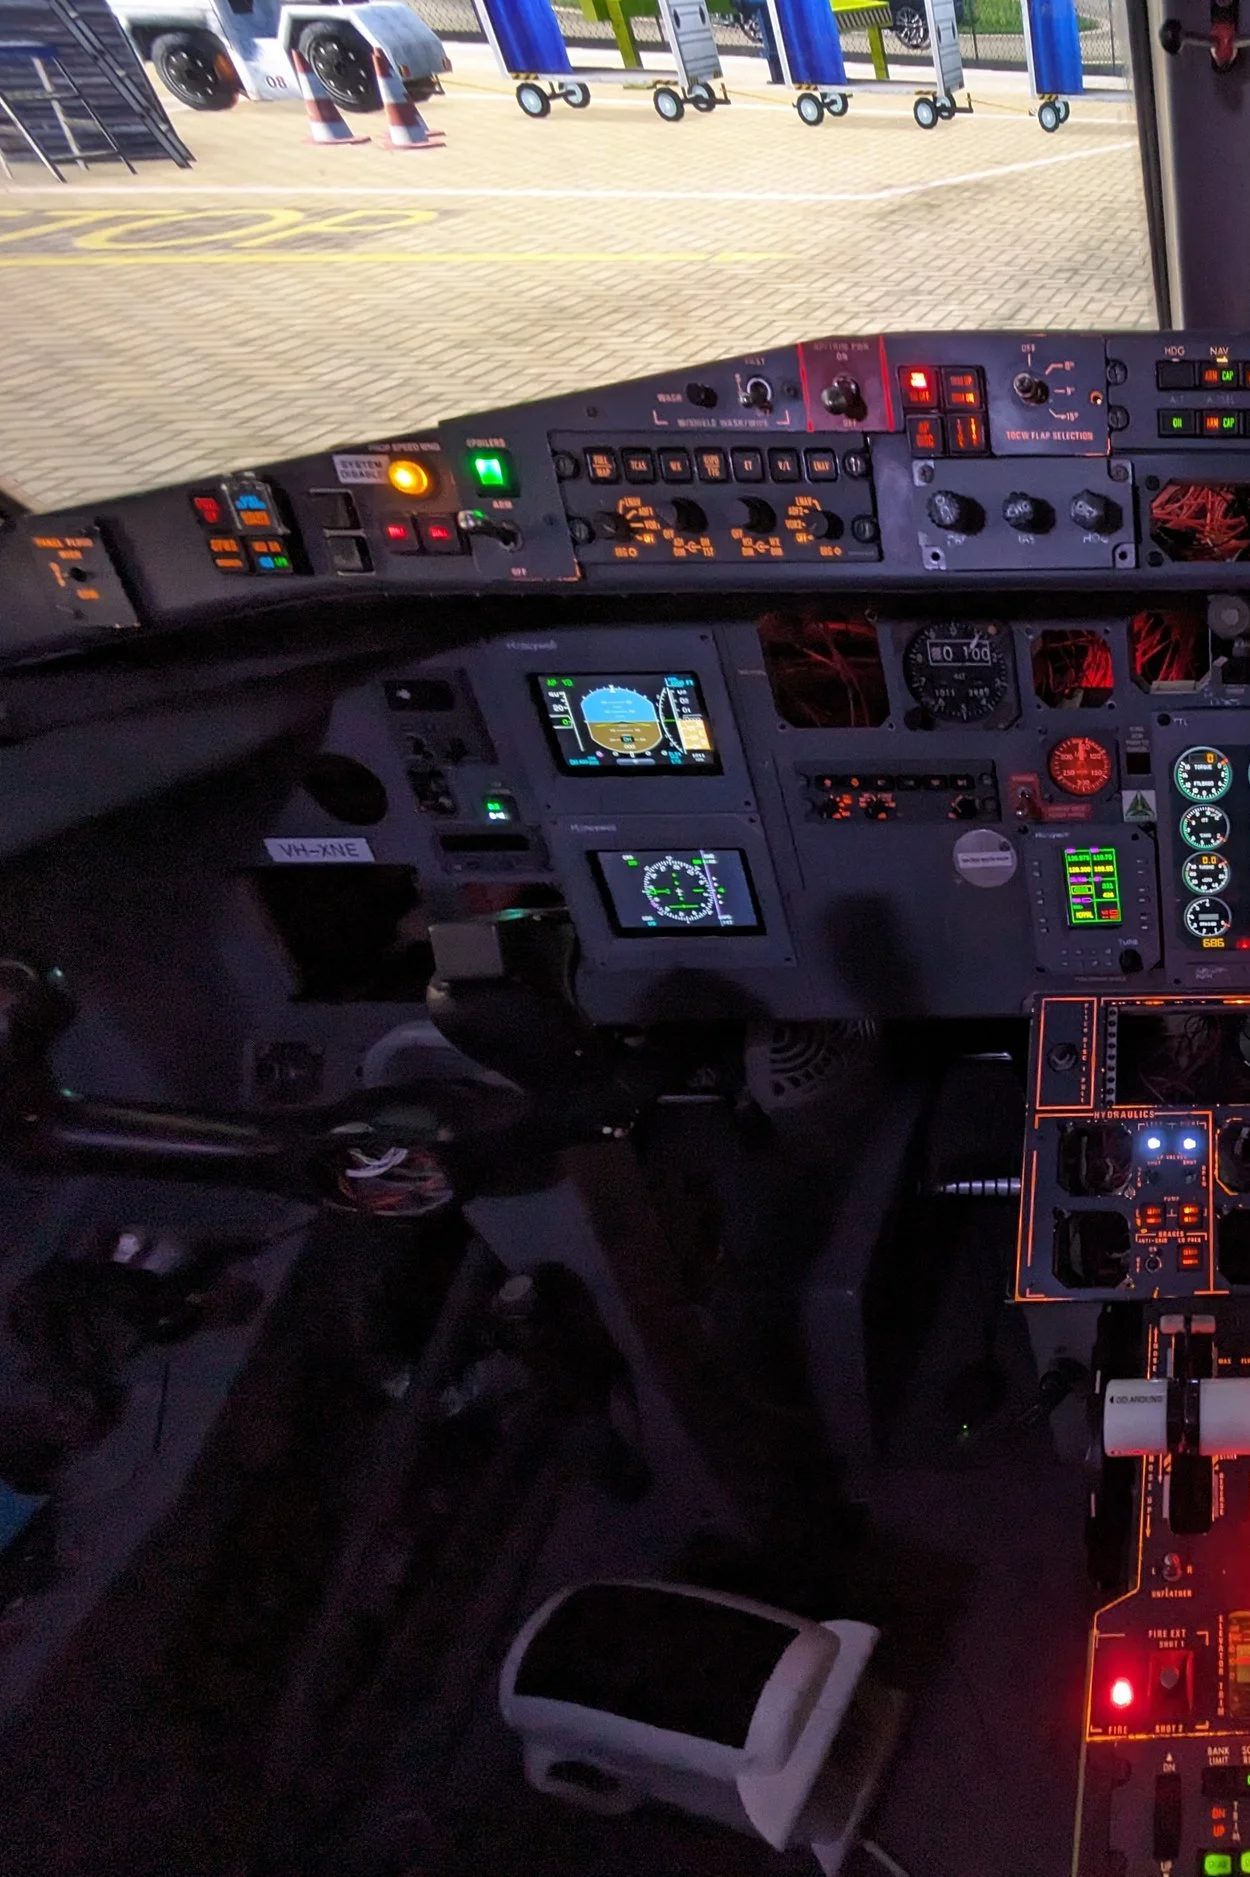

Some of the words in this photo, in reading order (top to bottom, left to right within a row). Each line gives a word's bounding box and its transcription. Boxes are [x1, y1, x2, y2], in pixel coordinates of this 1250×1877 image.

[1165, 346, 1185, 356] HDG
[1210, 346, 1229, 356] NAV
[1205, 371, 1218, 381] ARM
[1222, 371, 1233, 380] CAP
[1172, 419, 1182, 428] ON
[1207, 418, 1218, 428] ARM
[1223, 418, 1234, 428] CAP
[1031, 431, 1049, 440] FLAP
[1053, 431, 1093, 440] SELECTION
[630, 461, 647, 470] TCAS
[342, 470, 385, 479] DISABLE
[962, 646, 989, 661] 100
[1207, 753, 1214, 763] 0
[279, 843, 360, 857] VH-XNE
[1202, 856, 1217, 864] 0.0
[1094, 1110, 1155, 1119] HYDRAULICS
[1152, 1567, 1156, 1575] L
[1151, 1589, 1193, 1598] UNFEATHER
[1148, 1629, 1168, 1638] FIRE
[1170, 1628, 1186, 1638] EXT
[1159, 1640, 1178, 1648] SHOT
[1181, 1640, 1185, 1648] 1
[1217, 1681, 1225, 1716] TRIM
[1108, 1725, 1128, 1734] FIRE
[1155, 1724, 1176, 1733] SHOT
[1208, 1746, 1230, 1755] BANK
[1209, 1756, 1229, 1765] LIMIT
[1163, 1763, 1175, 1772] DN
[1213, 1824, 1226, 1837] UP
